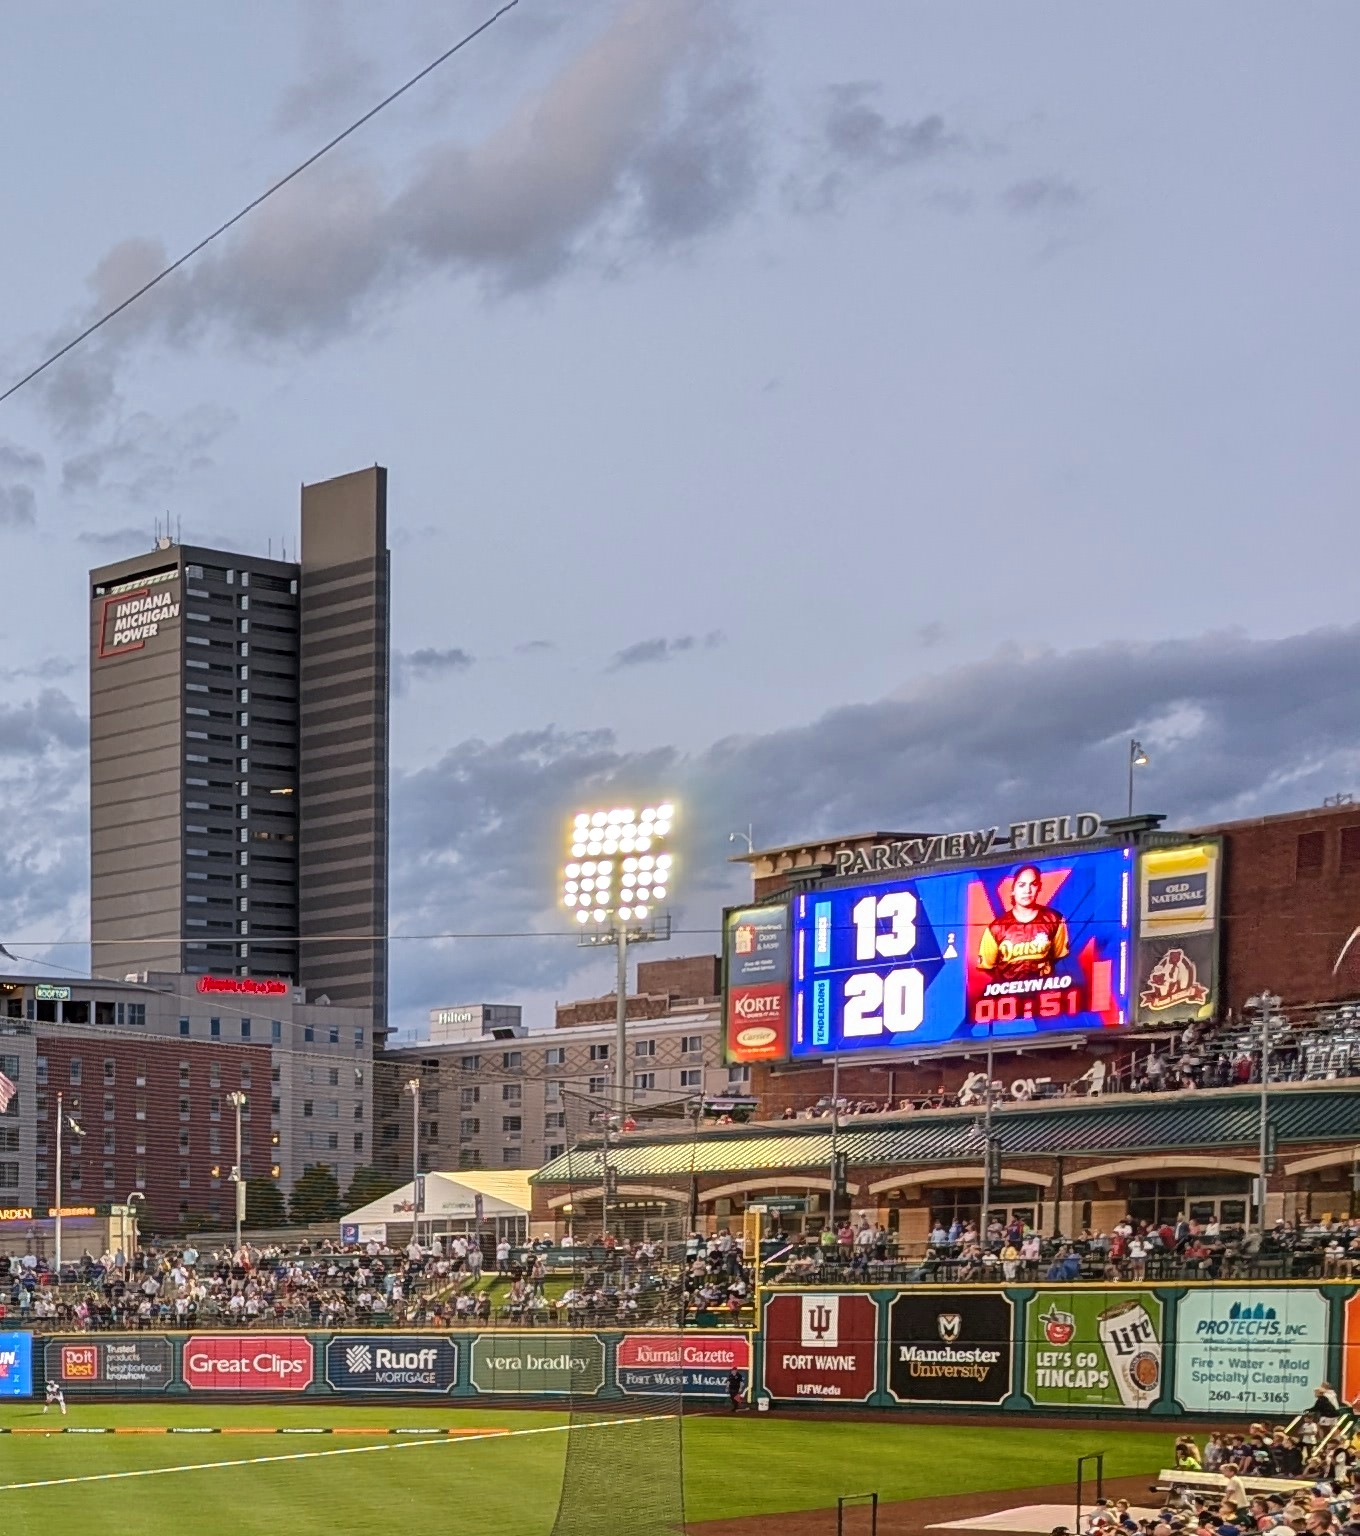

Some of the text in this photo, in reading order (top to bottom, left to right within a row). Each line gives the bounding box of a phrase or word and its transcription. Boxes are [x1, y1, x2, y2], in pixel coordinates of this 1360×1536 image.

[116, 592, 172, 617] INDIANA
[114, 603, 179, 631] MICHIGAN
[113, 623, 158, 645] POWER
[835, 812, 1102, 875] PARKVIEW FIELD
[1151, 889, 1204, 904] NATIONAL
[1166, 883, 1189, 893] OLD
[853, 891, 917, 960] 13
[984, 976, 1072, 996] JOCELYN ALO
[735, 994, 780, 1017] KORTE
[843, 968, 924, 1037] 20
[974, 991, 1078, 1023] 00:51
[1110, 1319, 1151, 1356] Lite
[190, 1353, 303, 1377] Great Clips
[376, 1348, 437, 1369] Ruoff
[486, 1354, 590, 1374] vera bradley
[635, 1347, 734, 1364] Journal Gazette
[783, 1355, 856, 1371] FORT WAYNE
[900, 1346, 1000, 1364] Manchester
[1036, 1352, 1098, 1367] LET'S GO
[1191, 1357, 1310, 1370] Fire Water Mold
[67, 1363, 92, 1376] Best
[376, 1371, 436, 1384] MORTGAGE
[909, 1360, 989, 1382] University
[1036, 1370, 1109, 1388] TINCAPS
[1192, 1371, 1308, 1387] Specialty Cleaning
[796, 1384, 841, 1396] IUFW.edu
[1209, 1390, 1290, 1402] 260-471-3165
